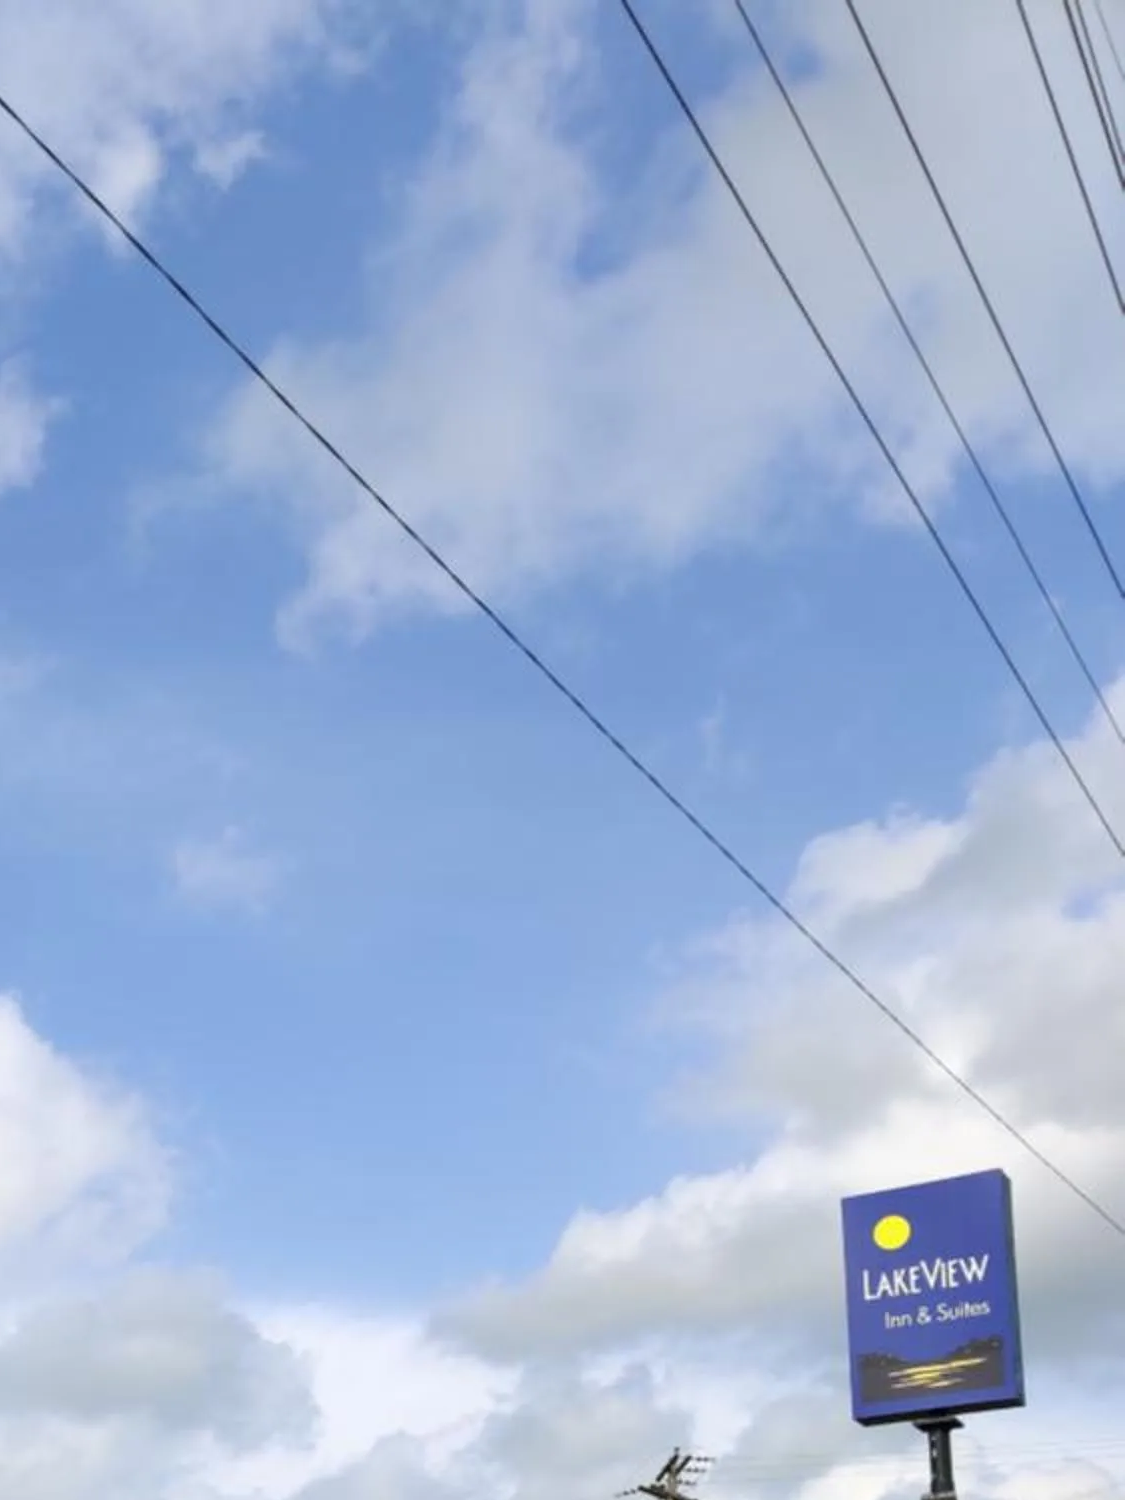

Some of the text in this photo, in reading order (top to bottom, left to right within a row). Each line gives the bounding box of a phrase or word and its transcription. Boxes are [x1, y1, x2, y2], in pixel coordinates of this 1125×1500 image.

[884, 1300, 991, 1329] Inn & Suites
